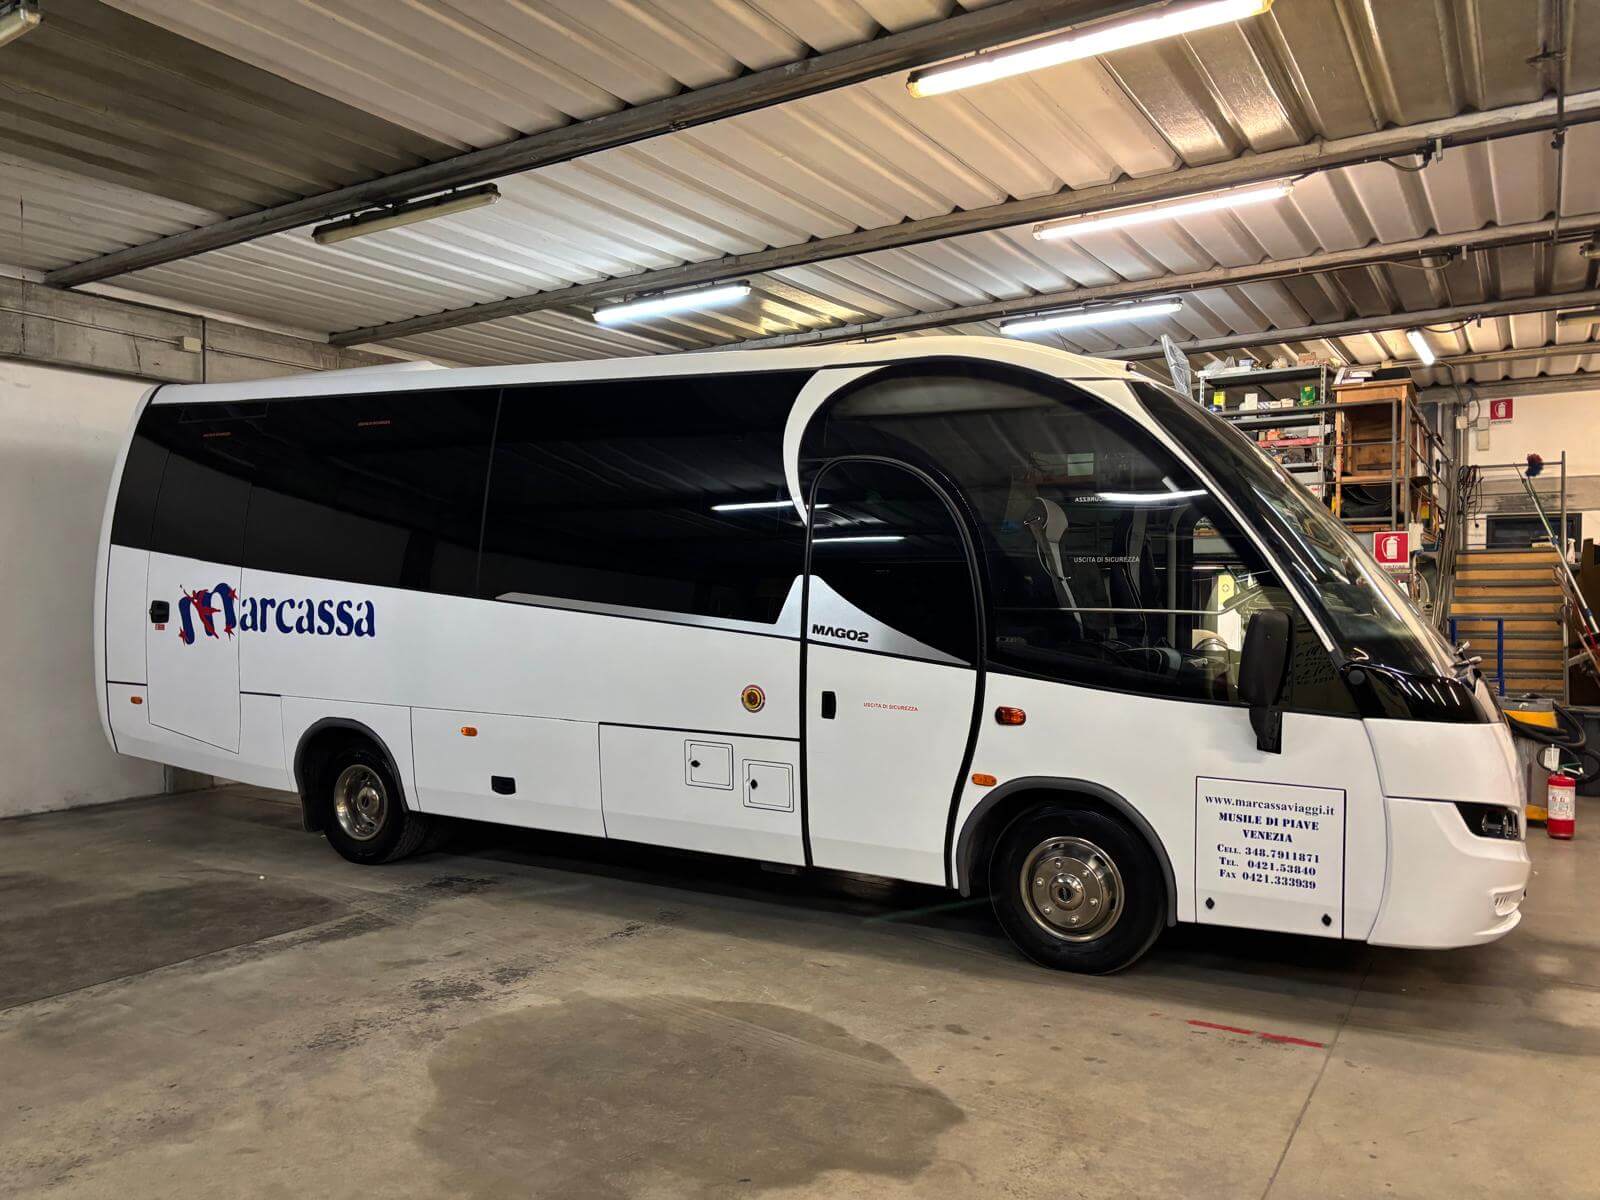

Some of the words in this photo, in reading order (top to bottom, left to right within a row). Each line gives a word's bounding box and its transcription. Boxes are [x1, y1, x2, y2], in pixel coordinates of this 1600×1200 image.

[178, 582, 376, 646] Marcassa
[812, 624, 870, 643] MAGO2
[889, 704, 918, 712] SICUREZZA
[1205, 795, 1336, 816] www.marcassaviaggi.it
[1218, 812, 1262, 825] MUSILE
[1266, 816, 1279, 827] DI
[1282, 818, 1320, 831] PIAVE
[1242, 829, 1293, 843] VENEZIA
[1245, 847, 1320, 864] 348.7911871
[1247, 860, 1316, 876] 0421.53840
[1242, 872, 1316, 890] 0421.333939
